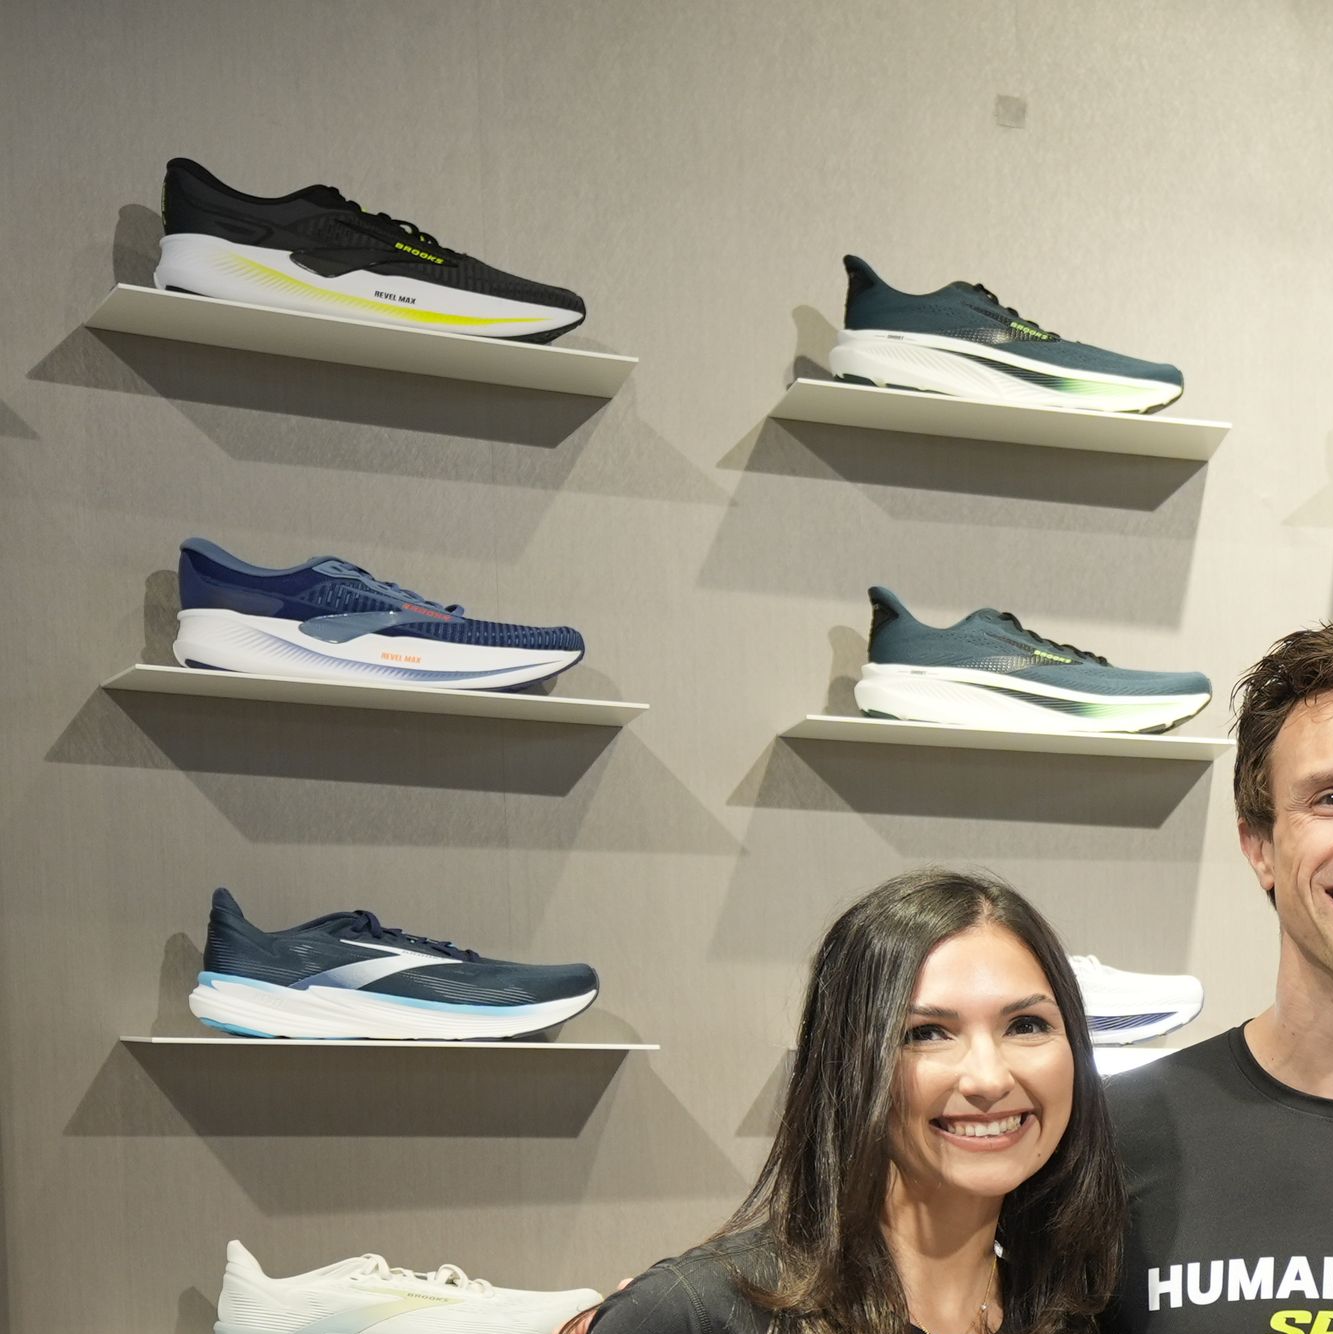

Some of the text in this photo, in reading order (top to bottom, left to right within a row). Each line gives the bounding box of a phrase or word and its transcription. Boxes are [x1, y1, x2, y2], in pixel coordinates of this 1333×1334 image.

[395, 242, 445, 264] BROOKS
[374, 291, 417, 305] REVEL MAX
[1010, 322, 1049, 340] BROOKS
[381, 651, 422, 664] REVEL MAX
[1034, 650, 1072, 664] BROOKS
